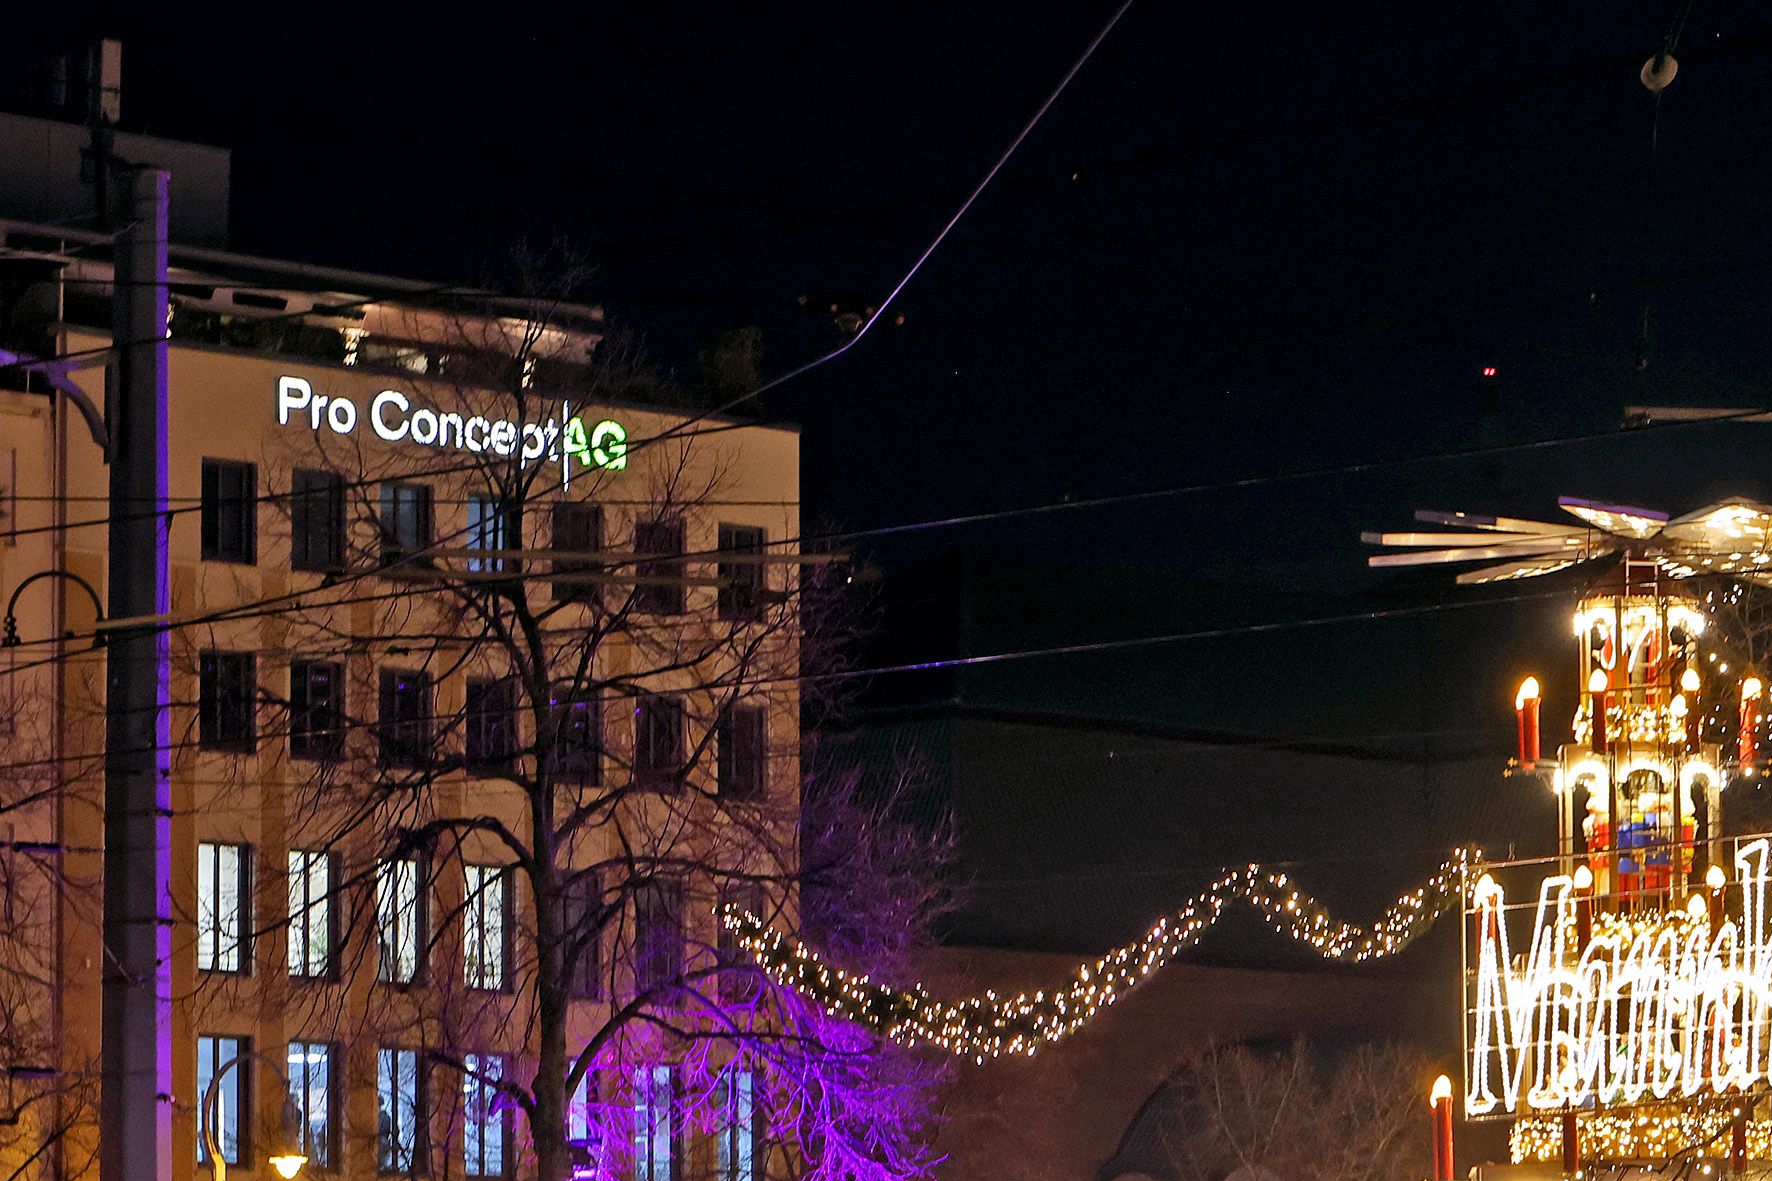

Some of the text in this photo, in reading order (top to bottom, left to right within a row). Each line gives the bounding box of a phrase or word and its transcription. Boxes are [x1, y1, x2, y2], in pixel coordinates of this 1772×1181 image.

[278, 375, 629, 471] Pro Concept AG
